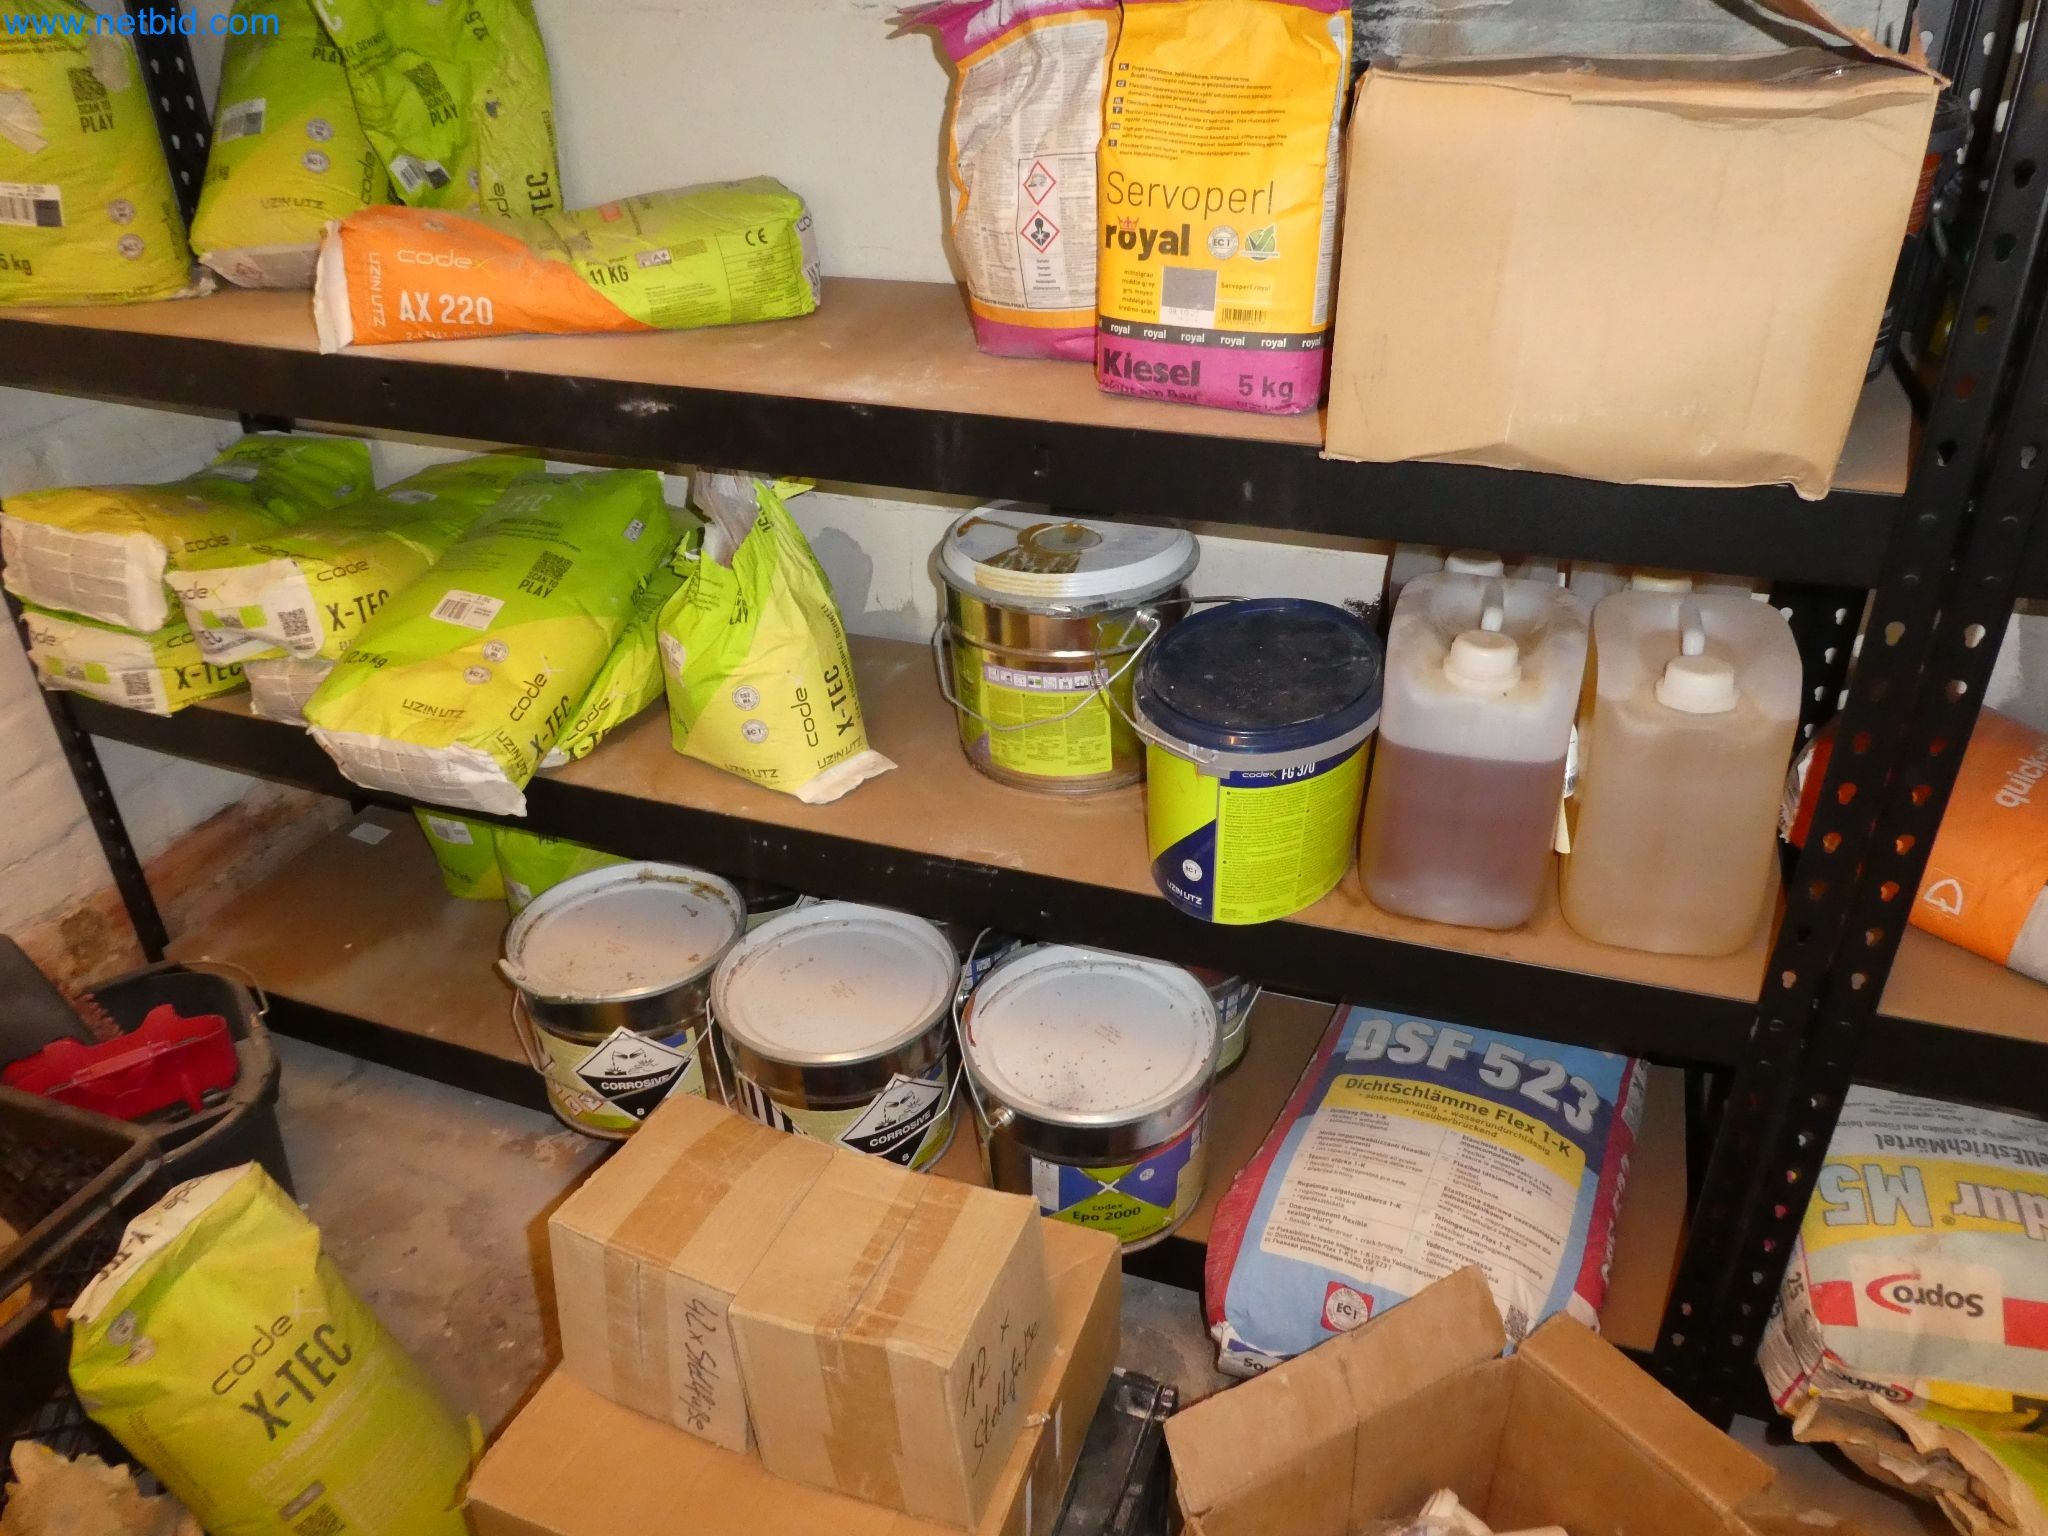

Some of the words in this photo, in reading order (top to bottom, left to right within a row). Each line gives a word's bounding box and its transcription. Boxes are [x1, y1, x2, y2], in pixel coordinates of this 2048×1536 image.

[1106, 170, 1274, 220] Servoperl
[1105, 223, 1191, 261] royal
[589, 268, 607, 287] 11
[609, 265, 630, 286] KG
[400, 290, 433, 323] AX
[438, 293, 494, 326] 220
[1110, 322, 1131, 336] royal
[1143, 325, 1167, 341] royal
[1180, 331, 1206, 344] royal
[1220, 334, 1246, 347] royal
[1260, 337, 1287, 349] royal
[1301, 335, 1322, 349] royal
[1103, 347, 1201, 387] Kiesel
[1238, 373, 1254, 397] 5
[1261, 376, 1295, 404] kg
[517, 578, 555, 600] PLAY
[402, 698, 438, 717] UZIN
[438, 708, 467, 720] UTZ
[823, 664, 855, 737] X-TEC
[530, 694, 572, 761] X-TEC
[817, 748, 844, 770] UZIN
[843, 735, 864, 753] UTZ
[1166, 879, 1183, 897] UZIN
[1183, 892, 1203, 906] UTZ
[600, 1074, 672, 1091] CORROSIVE
[1345, 1016, 1476, 1073] DSF
[1478, 1040, 1601, 1135] 523
[636, 1107, 646, 1116] 8
[869, 1109, 932, 1148] CORROSIVE
[1345, 1077, 1490, 1117] DichtSchlämme
[1494, 1108, 1536, 1136] Flex
[1542, 1130, 1572, 1158] 1-K
[1091, 1203, 1124, 1212] codex
[1818, 1163, 1934, 1229] M5
[1072, 1210, 1100, 1223] Epo
[1103, 1206, 1142, 1221] 2000
[1892, 1282, 1985, 1318] Sopro
[239, 1322, 354, 1442] X-TEC
